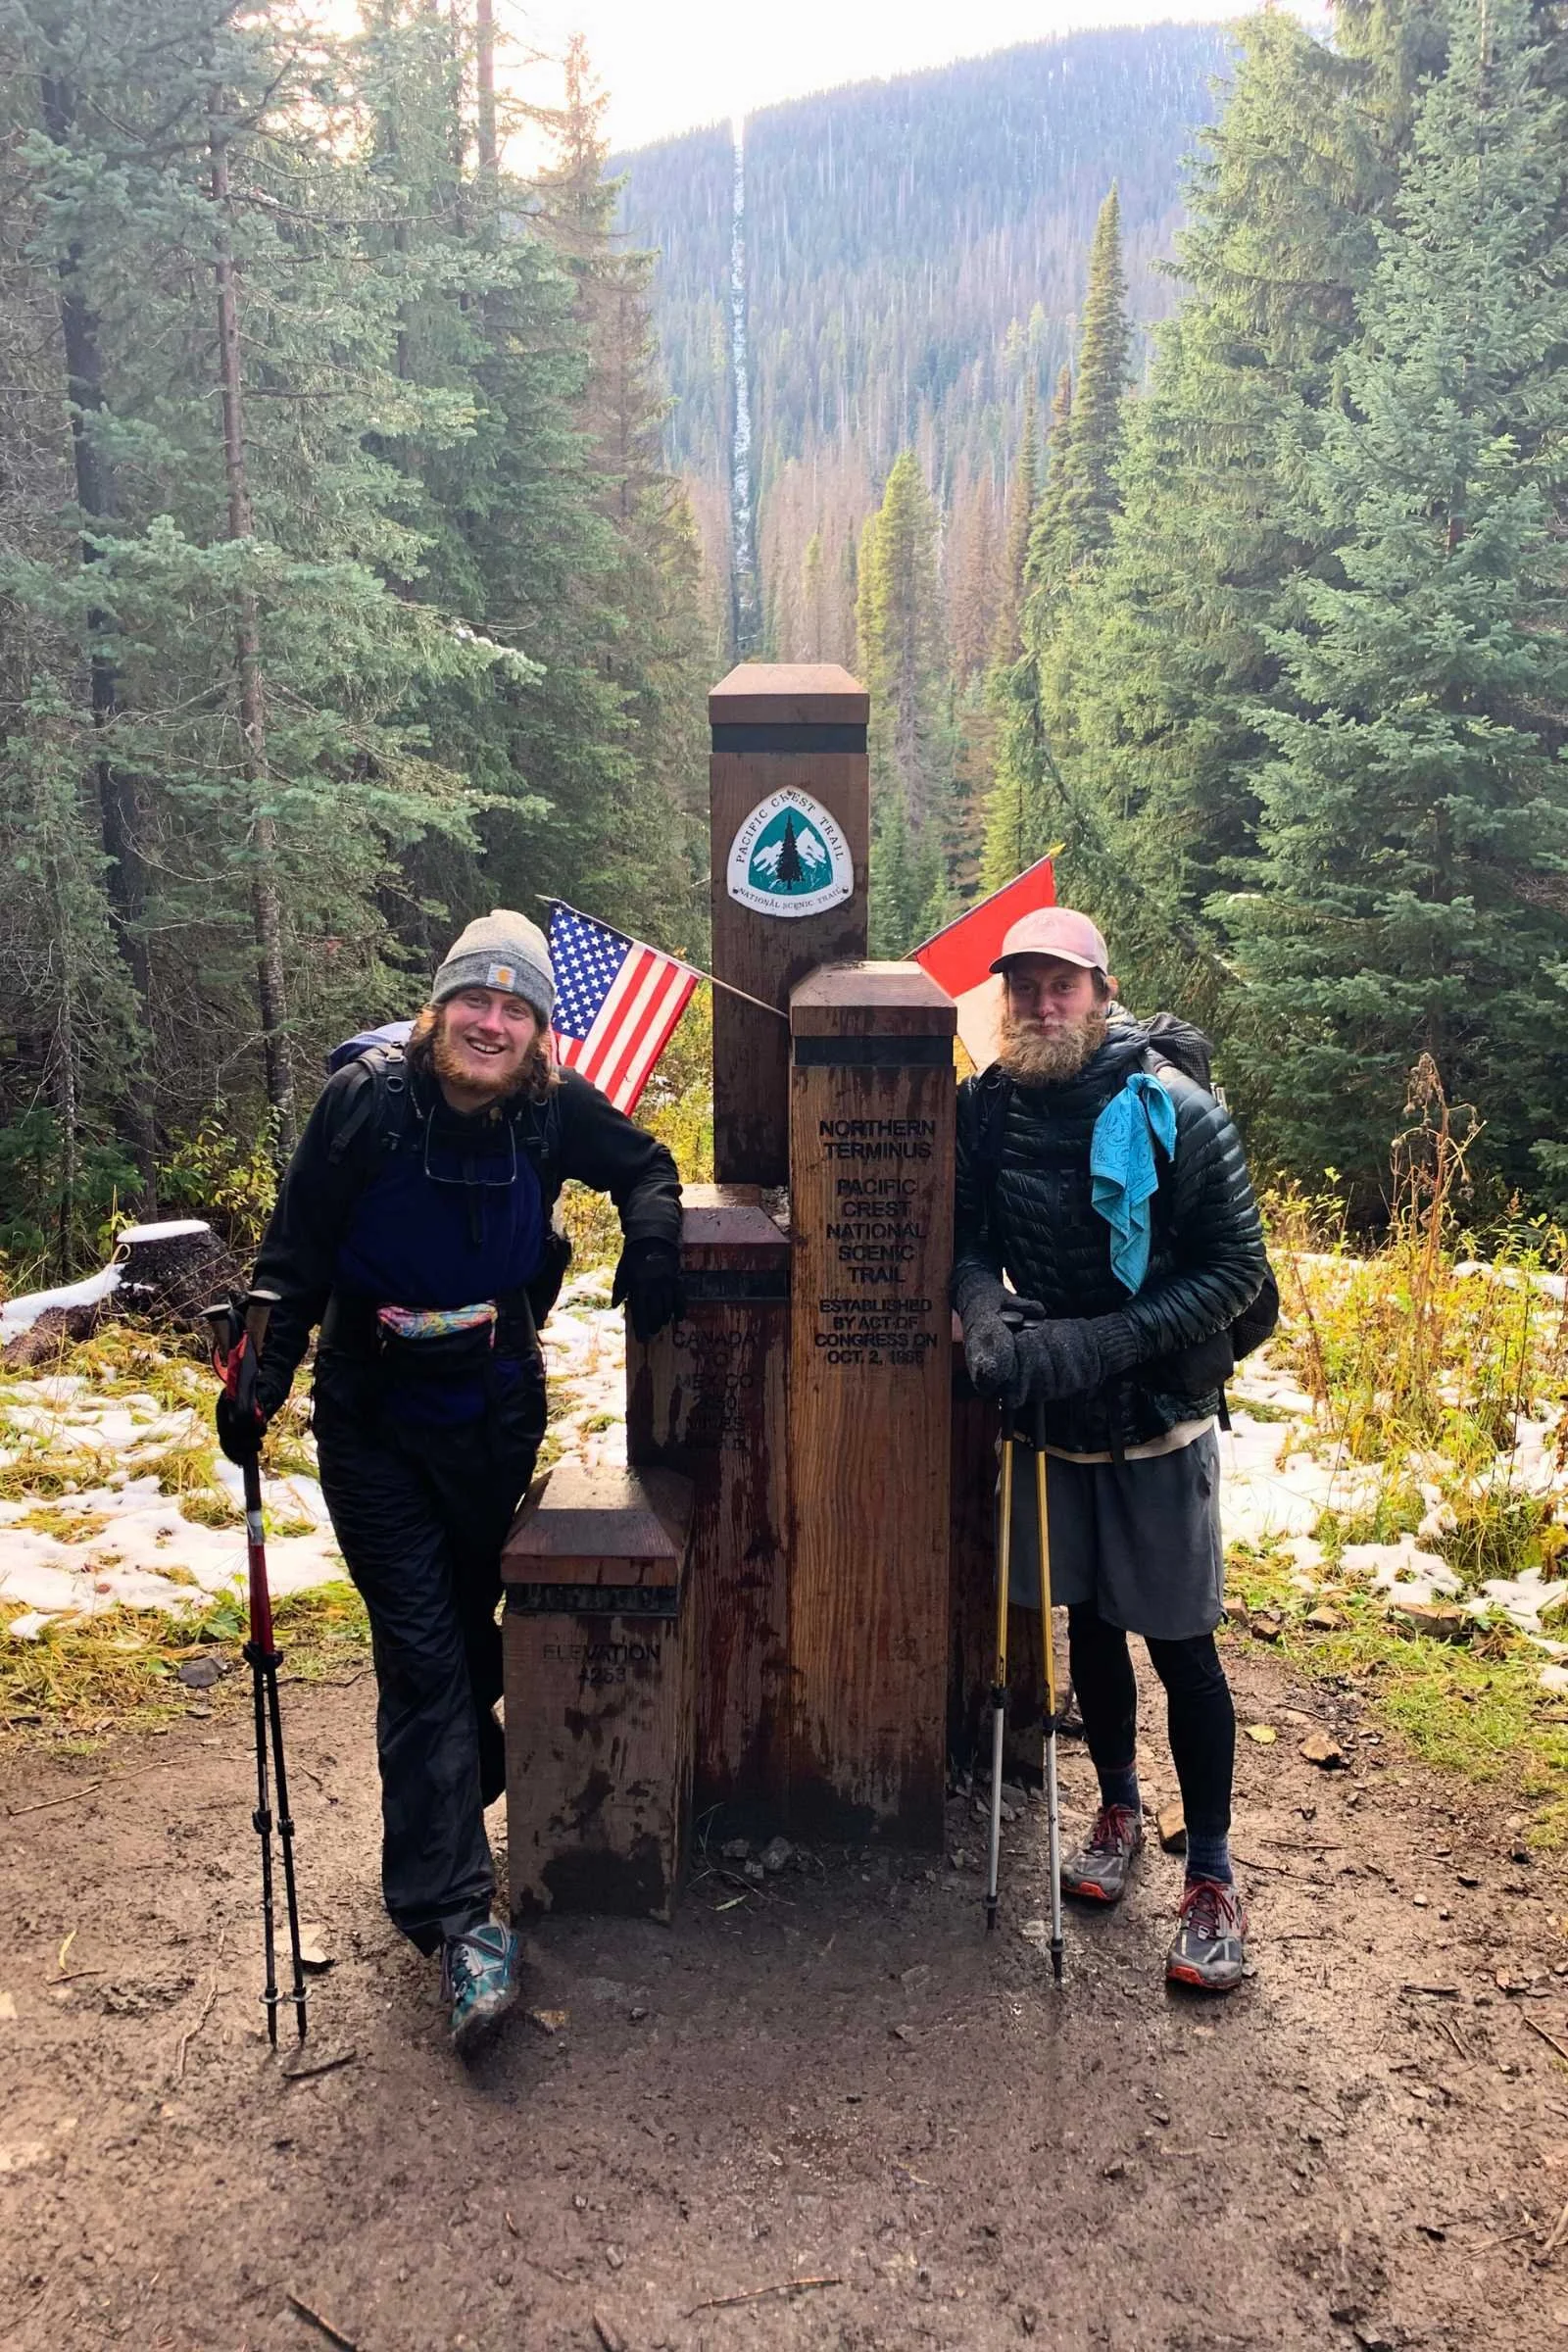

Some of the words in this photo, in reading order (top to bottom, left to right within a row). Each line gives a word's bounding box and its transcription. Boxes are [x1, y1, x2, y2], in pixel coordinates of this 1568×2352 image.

[736, 809, 768, 864] PACIFIC
[819, 816, 846, 861] TRAIL
[738, 887, 780, 909] NATIONAL
[782, 900, 814, 910] SCENIC
[817, 887, 842, 904] TRAIL
[819, 1119, 936, 1138] NORTHERN
[823, 1142, 932, 1159] TERMINUS
[838, 1178, 918, 1196] PACIFIC
[842, 1200, 912, 1218] CREST
[826, 1223, 927, 1240] NATIONAL
[839, 1245, 915, 1261] SCENIC
[847, 1266, 906, 1284] TRAIL
[819, 1298, 933, 1313] ESTABLISHED
[834, 1316, 857, 1330] BY
[858, 1316, 893, 1330] ACT
[896, 1316, 919, 1331] OF
[672, 1331, 759, 1349] CANADA
[815, 1333, 909, 1348] CONGRESS
[912, 1333, 938, 1348] ON
[828, 1349, 864, 1365] OCT.
[675, 1373, 754, 1389] MEXCO
[543, 1644, 662, 1663] ELEVATION
